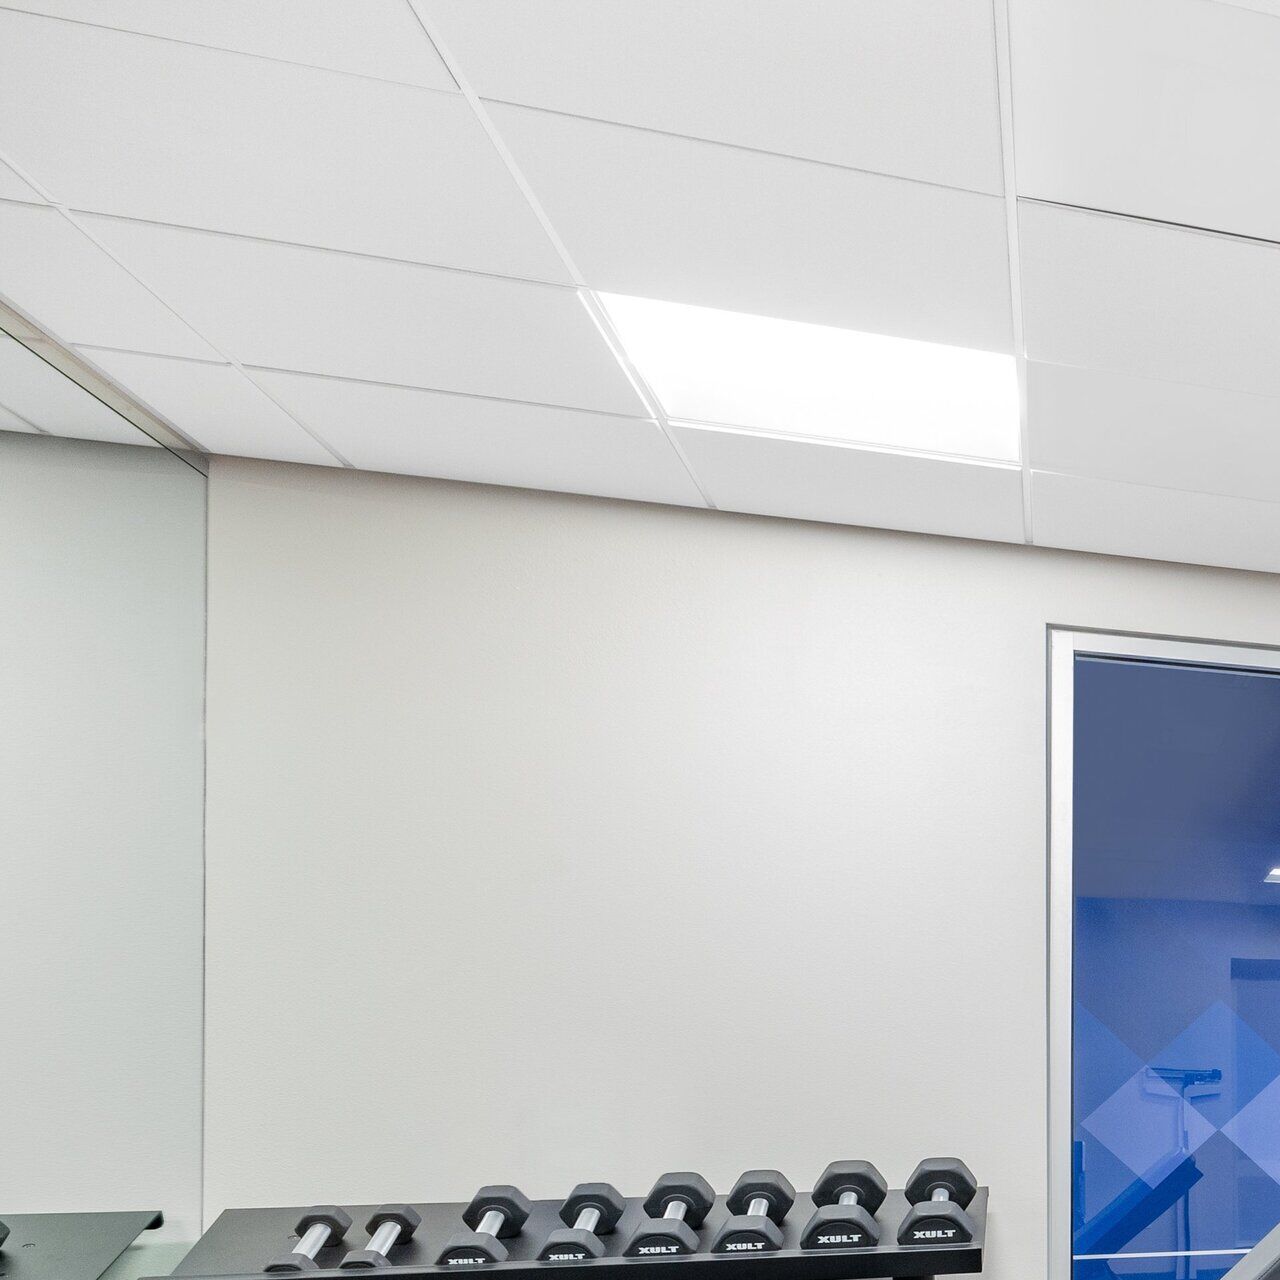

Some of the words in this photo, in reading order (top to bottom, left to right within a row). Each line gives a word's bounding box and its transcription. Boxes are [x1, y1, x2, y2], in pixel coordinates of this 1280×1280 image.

[914, 1230, 955, 1238] XULT
[818, 1235, 861, 1243] XULT
[639, 1246, 679, 1254] XULT
[447, 1257, 486, 1265] XULT
[548, 1253, 586, 1261] XULT
